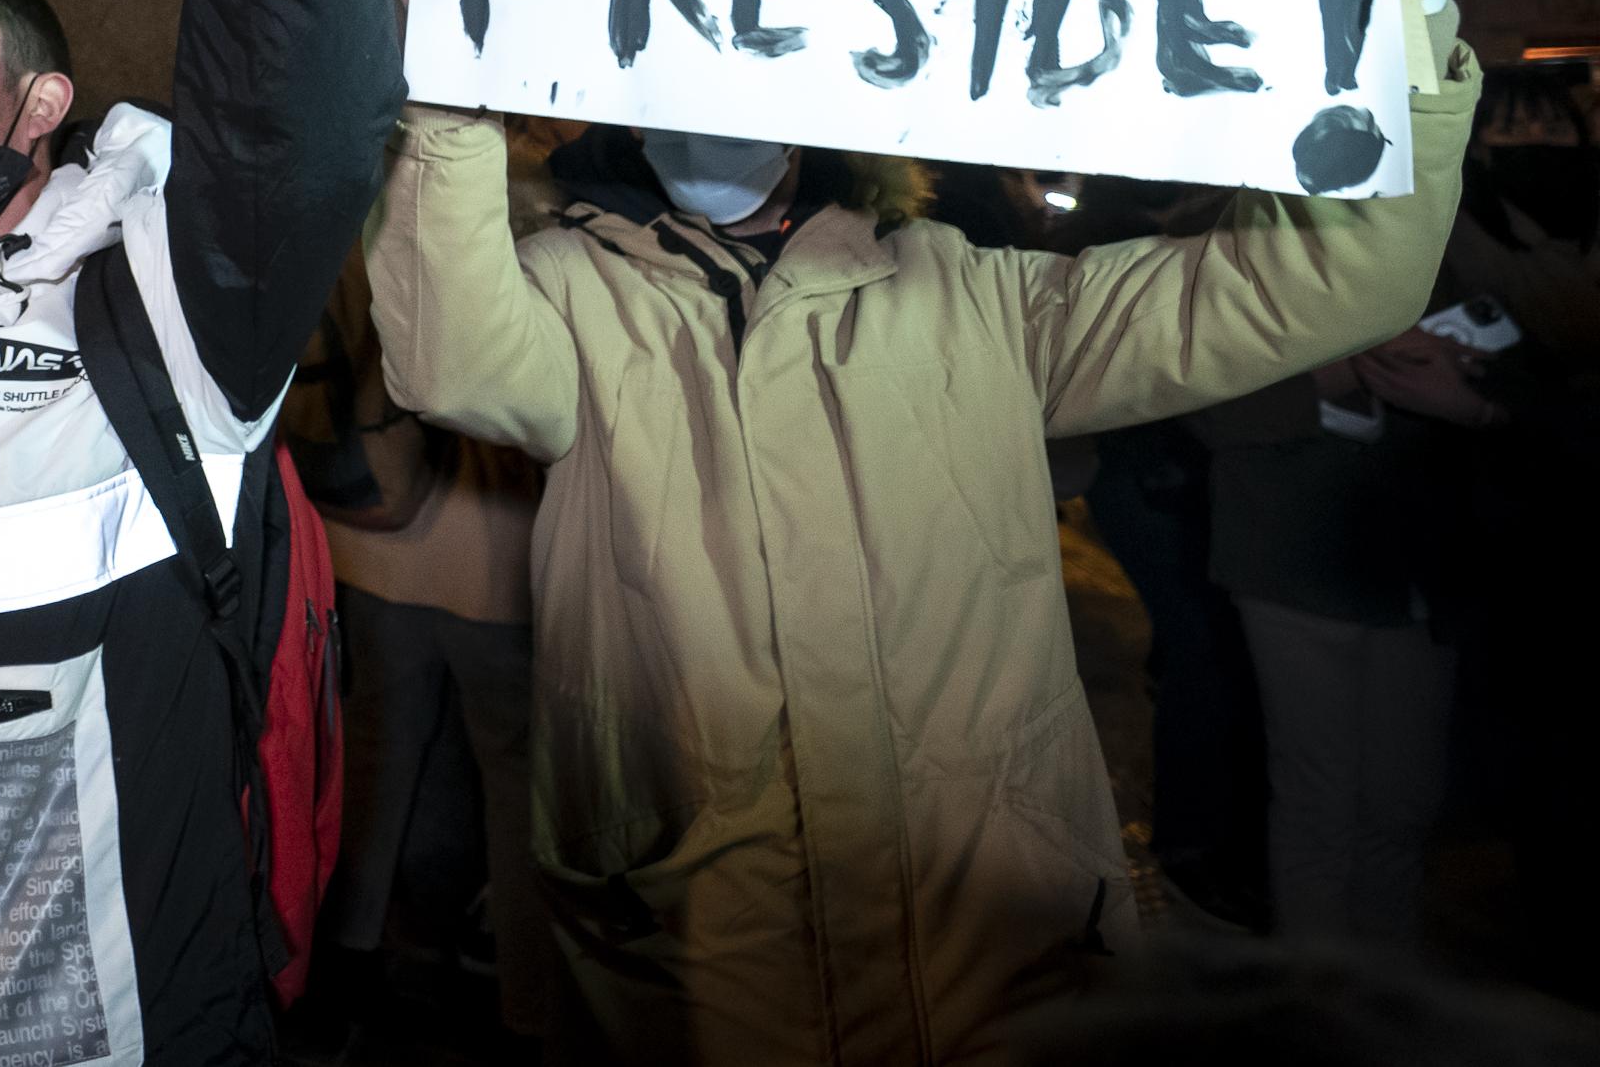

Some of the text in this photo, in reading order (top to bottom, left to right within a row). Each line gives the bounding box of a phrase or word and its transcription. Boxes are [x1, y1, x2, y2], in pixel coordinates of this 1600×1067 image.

[3, 389, 60, 403] SHUTTLE
[25, 879, 75, 897] Since
[9, 898, 63, 923] efforts
[40, 991, 68, 1014] the
[66, 1036, 82, 1059] is
